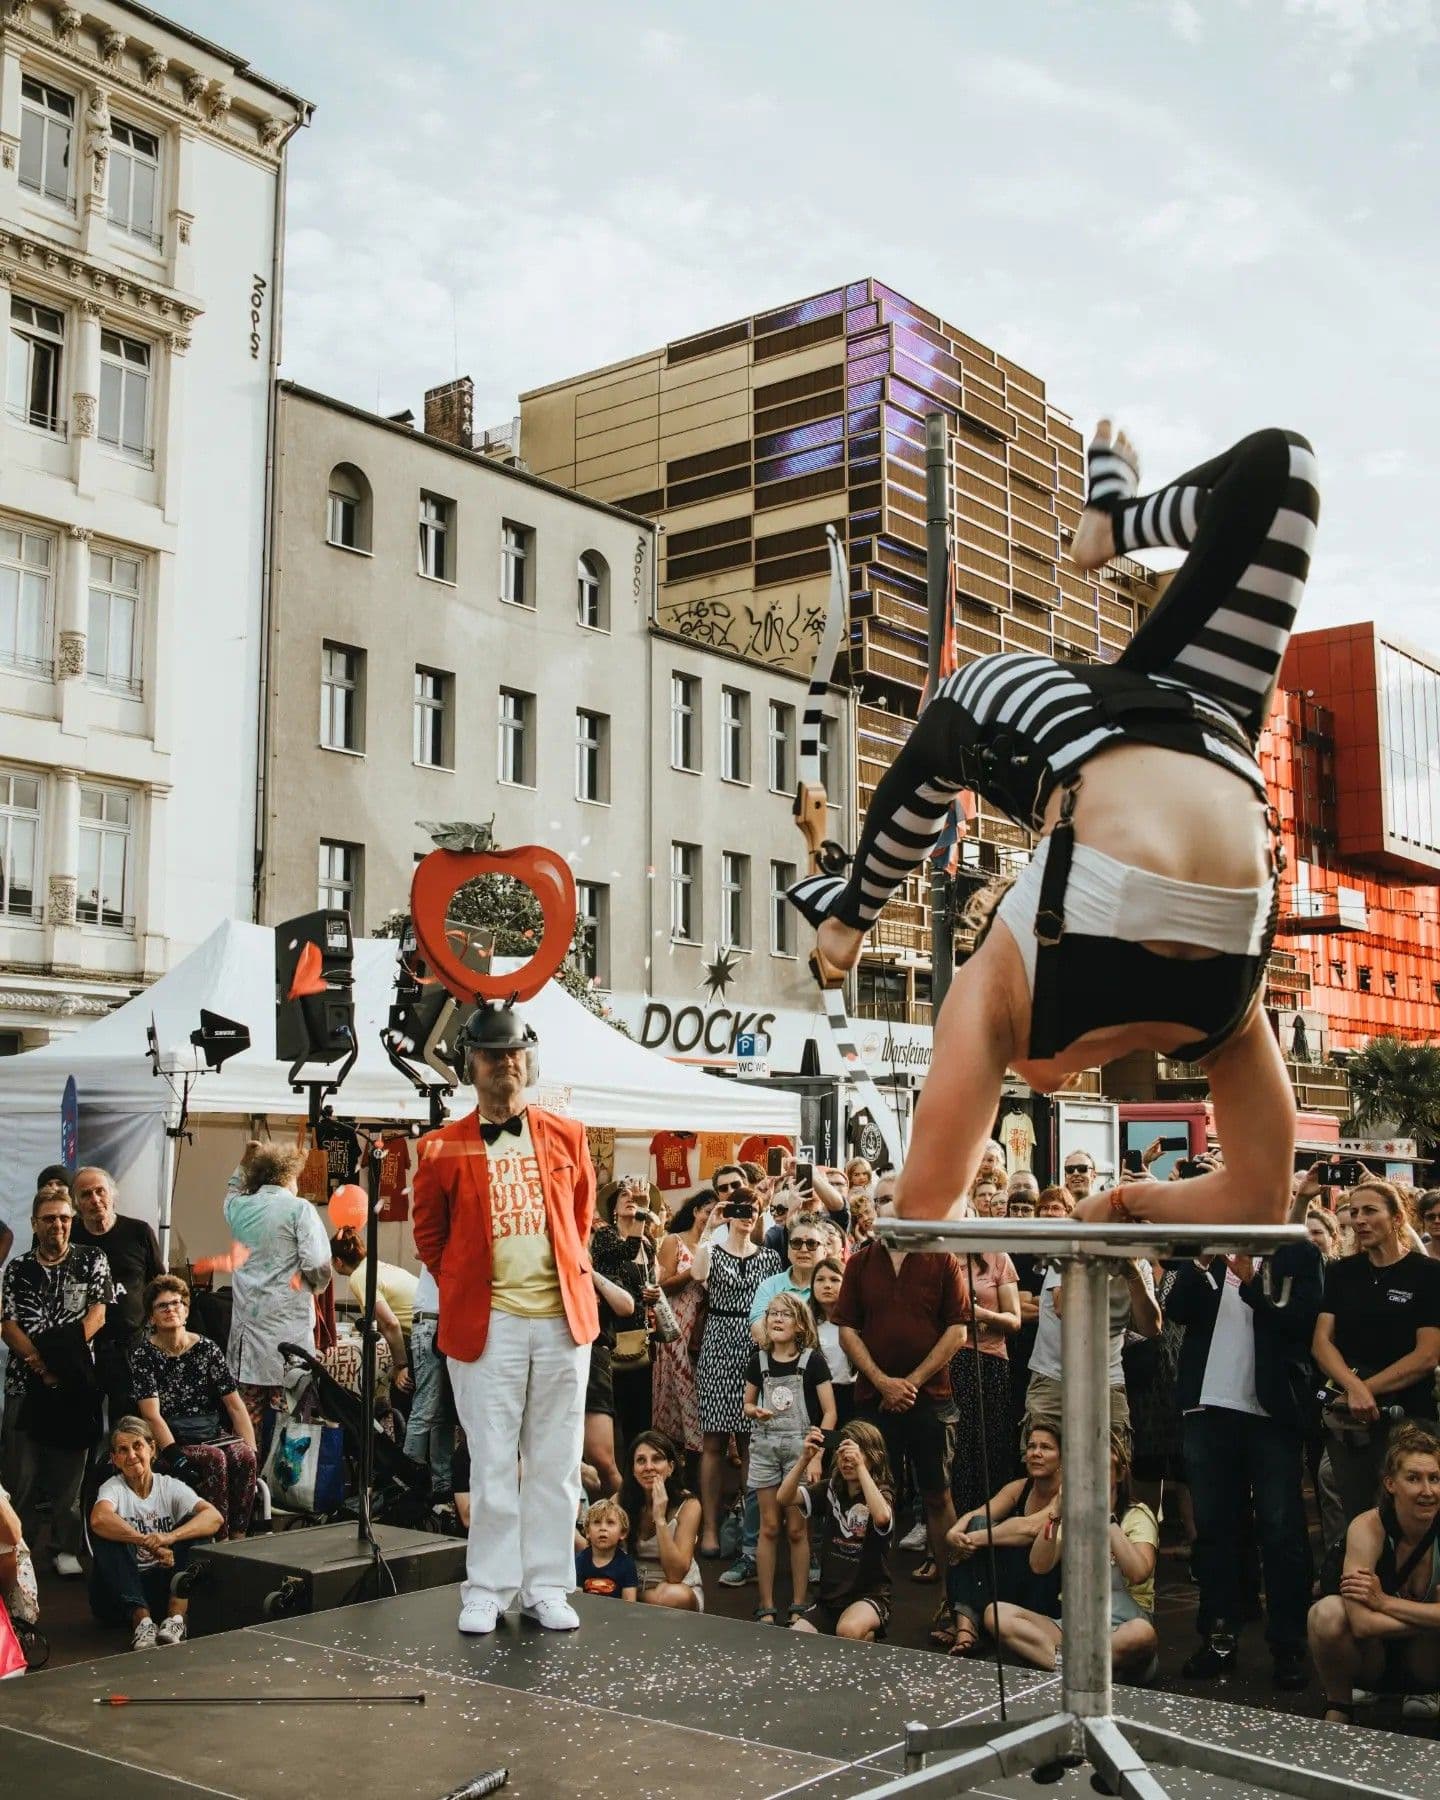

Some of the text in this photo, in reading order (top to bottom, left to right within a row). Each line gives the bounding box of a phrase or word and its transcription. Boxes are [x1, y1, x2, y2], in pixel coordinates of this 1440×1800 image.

[640, 1003, 776, 1054] DOCKS
[742, 1040, 750, 1054] P
[738, 1062, 753, 1072] WC
